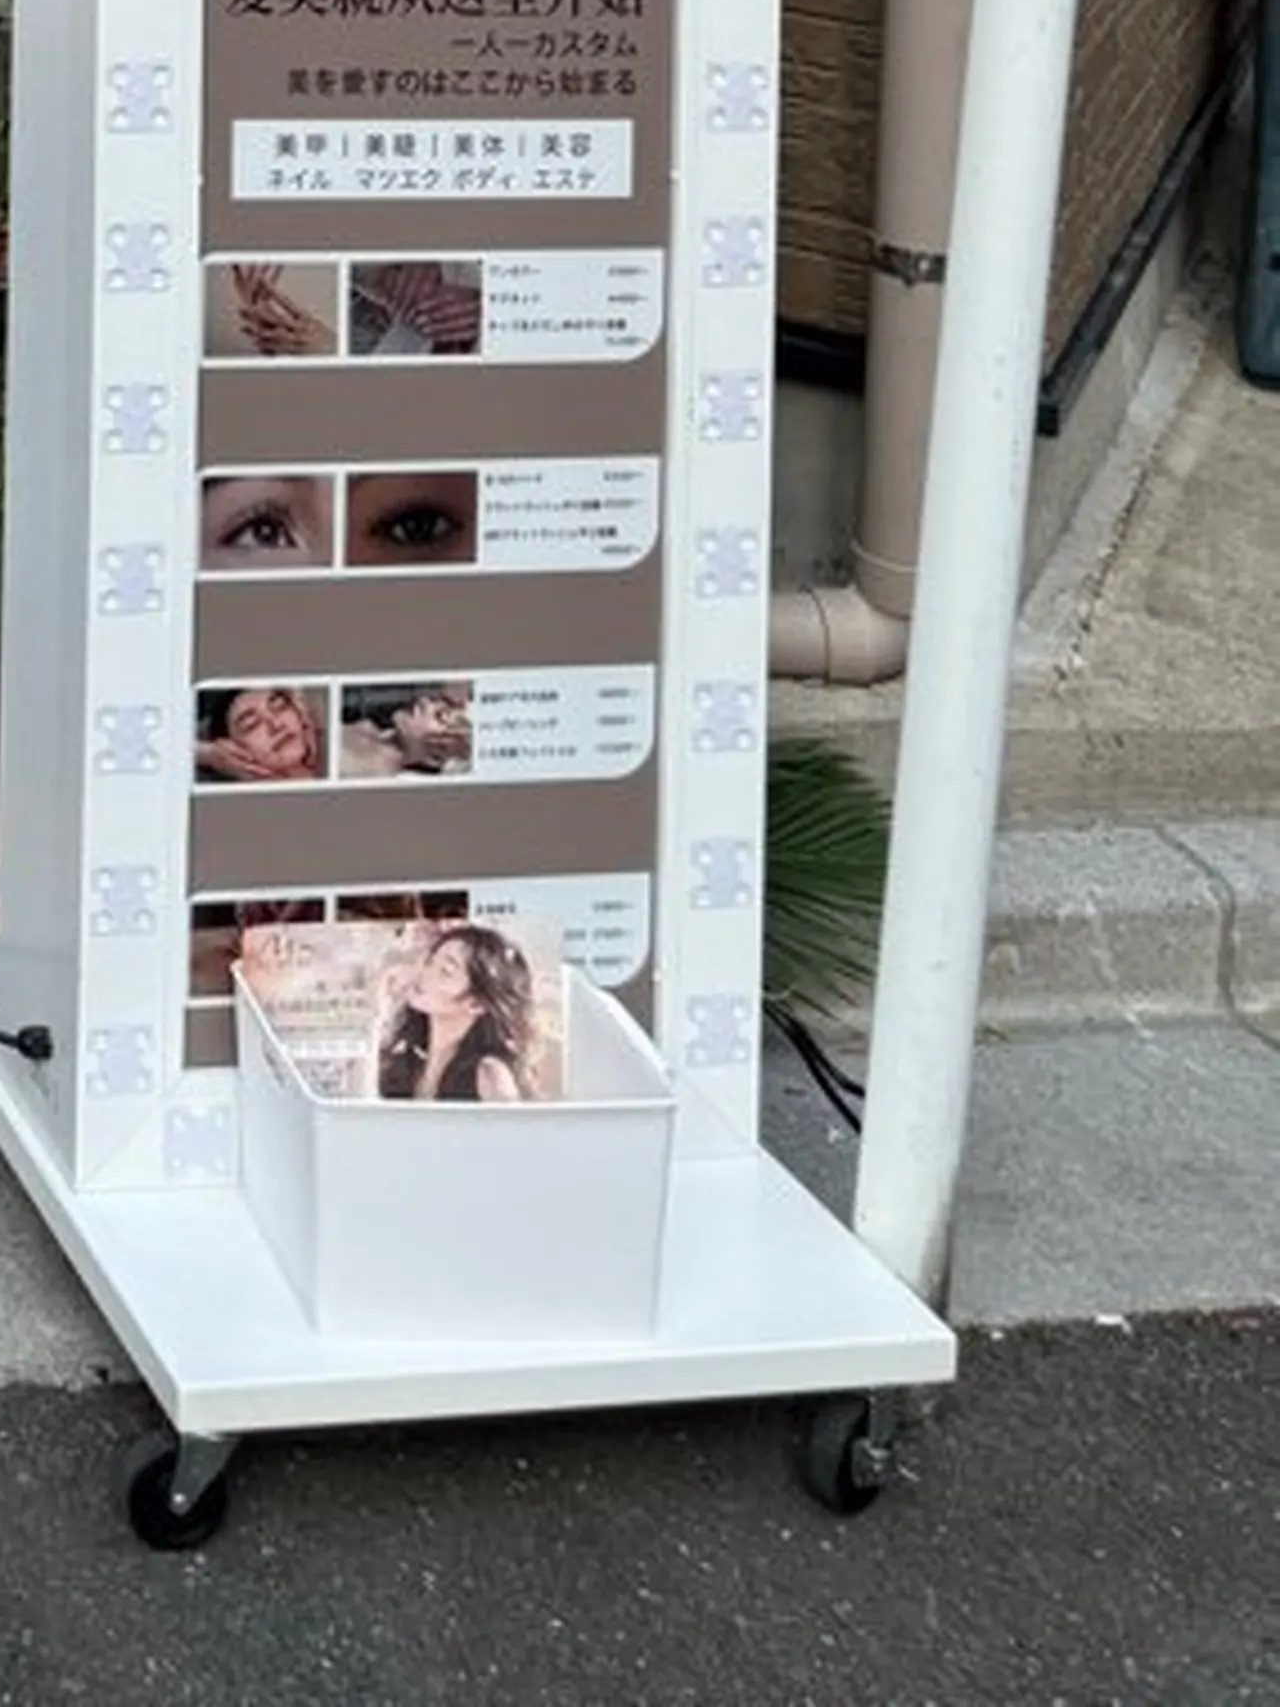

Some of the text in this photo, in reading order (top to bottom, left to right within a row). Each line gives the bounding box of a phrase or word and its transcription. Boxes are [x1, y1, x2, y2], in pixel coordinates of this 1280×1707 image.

[268, 168, 332, 190] ネイル
[355, 168, 440, 191] マツエク
[532, 167, 598, 190] エステ
